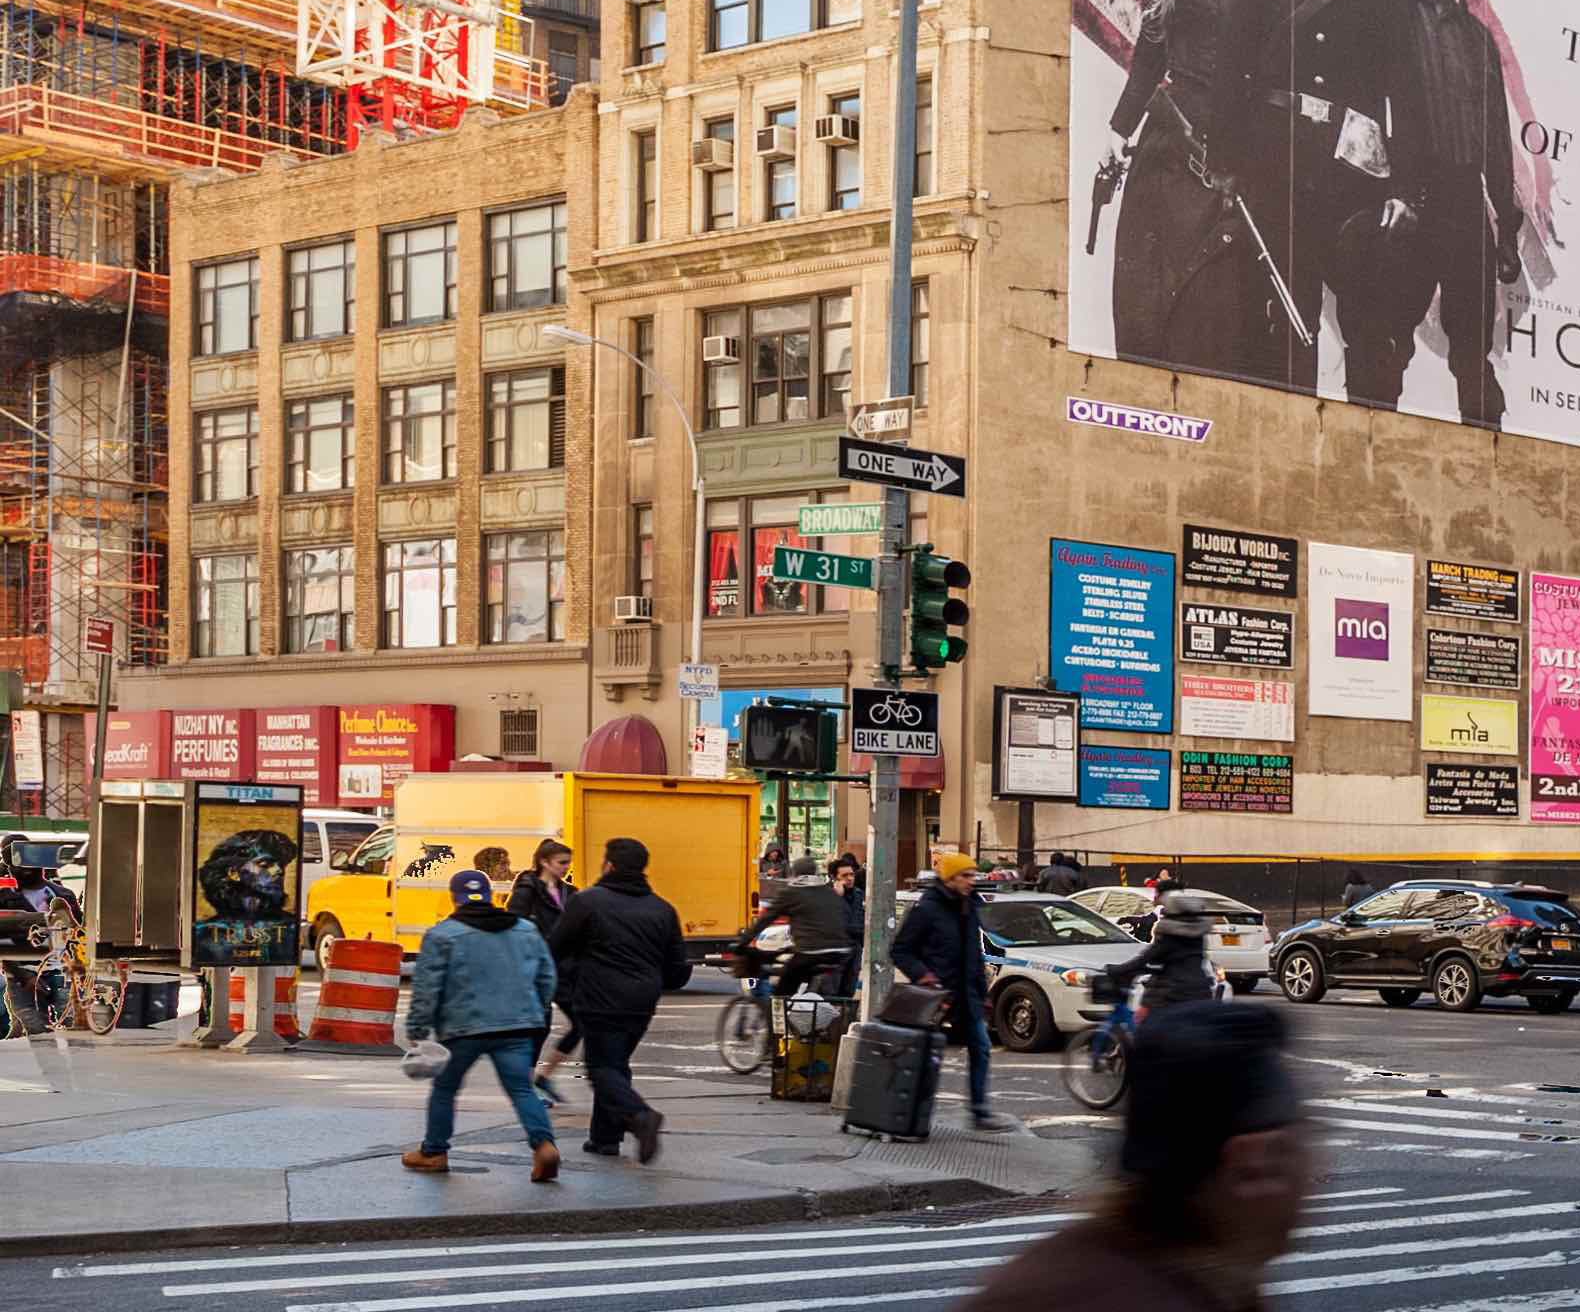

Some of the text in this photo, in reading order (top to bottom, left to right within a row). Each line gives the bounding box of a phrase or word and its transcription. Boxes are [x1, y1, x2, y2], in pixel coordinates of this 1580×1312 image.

[1520, 120, 1573, 161] OF
[1506, 291, 1573, 315] CHRISTIAN
[1530, 386, 1550, 405] IN
[856, 411, 905, 431] ONE WAY
[1072, 401, 1204, 438] OUTFRONT
[858, 453, 948, 482] ONE WAY
[801, 507, 880, 534] BROADWAY
[1192, 532, 1279, 560] BIJOUX WORLD
[785, 552, 866, 581] W 31 ST
[1431, 562, 1499, 581] MARCH TRADING
[1078, 574, 1152, 590] COSTUME JEWELRY
[1082, 585, 1148, 600] STERLING SILVER
[1084, 596, 1146, 611] STAINLESS STEEL
[1082, 608, 1105, 618] BELTS
[1185, 607, 1289, 633] ATLAS Fashion Corp.
[1070, 623, 1156, 640] FANTASIA GENERAL
[1337, 617, 1387, 641] mia
[1092, 636, 1117, 647] PLATA
[1193, 640, 1212, 649] USA
[1230, 638, 1284, 649] Costume Jewelry
[1467, 636, 1517, 652] Fashion Corp.
[1071, 645, 1101, 656] ACERO
[683, 665, 713, 675] NYPD
[1133, 702, 1154, 710] FLOOR
[174, 714, 224, 736] NUZHAT NY
[266, 714, 311, 730] MANHATTAN
[340, 710, 407, 733] Perfume Choice
[257, 735, 304, 752] FRAGRANCES
[857, 732, 934, 750] BIKE LANE
[174, 738, 238, 763] PERFUMES
[1553, 751, 1572, 765] DE
[1183, 752, 1291, 768] ODIN FASHION CORP.
[1183, 775, 1216, 783] IMPORTER
[1217, 775, 1227, 783] OF
[1230, 776, 1245, 784] HAIR
[1437, 769, 1510, 780] Fantasia de Moda
[225, 788, 273, 800] TITAN
[1183, 783, 1212, 792] COSTUME
[1215, 784, 1242, 792] JEWELRY
[1245, 785, 1257, 793] AND
[1429, 796, 1460, 804] Taiwan
[1465, 797, 1498, 806] Jewelry
[208, 926, 287, 944] TRUST
